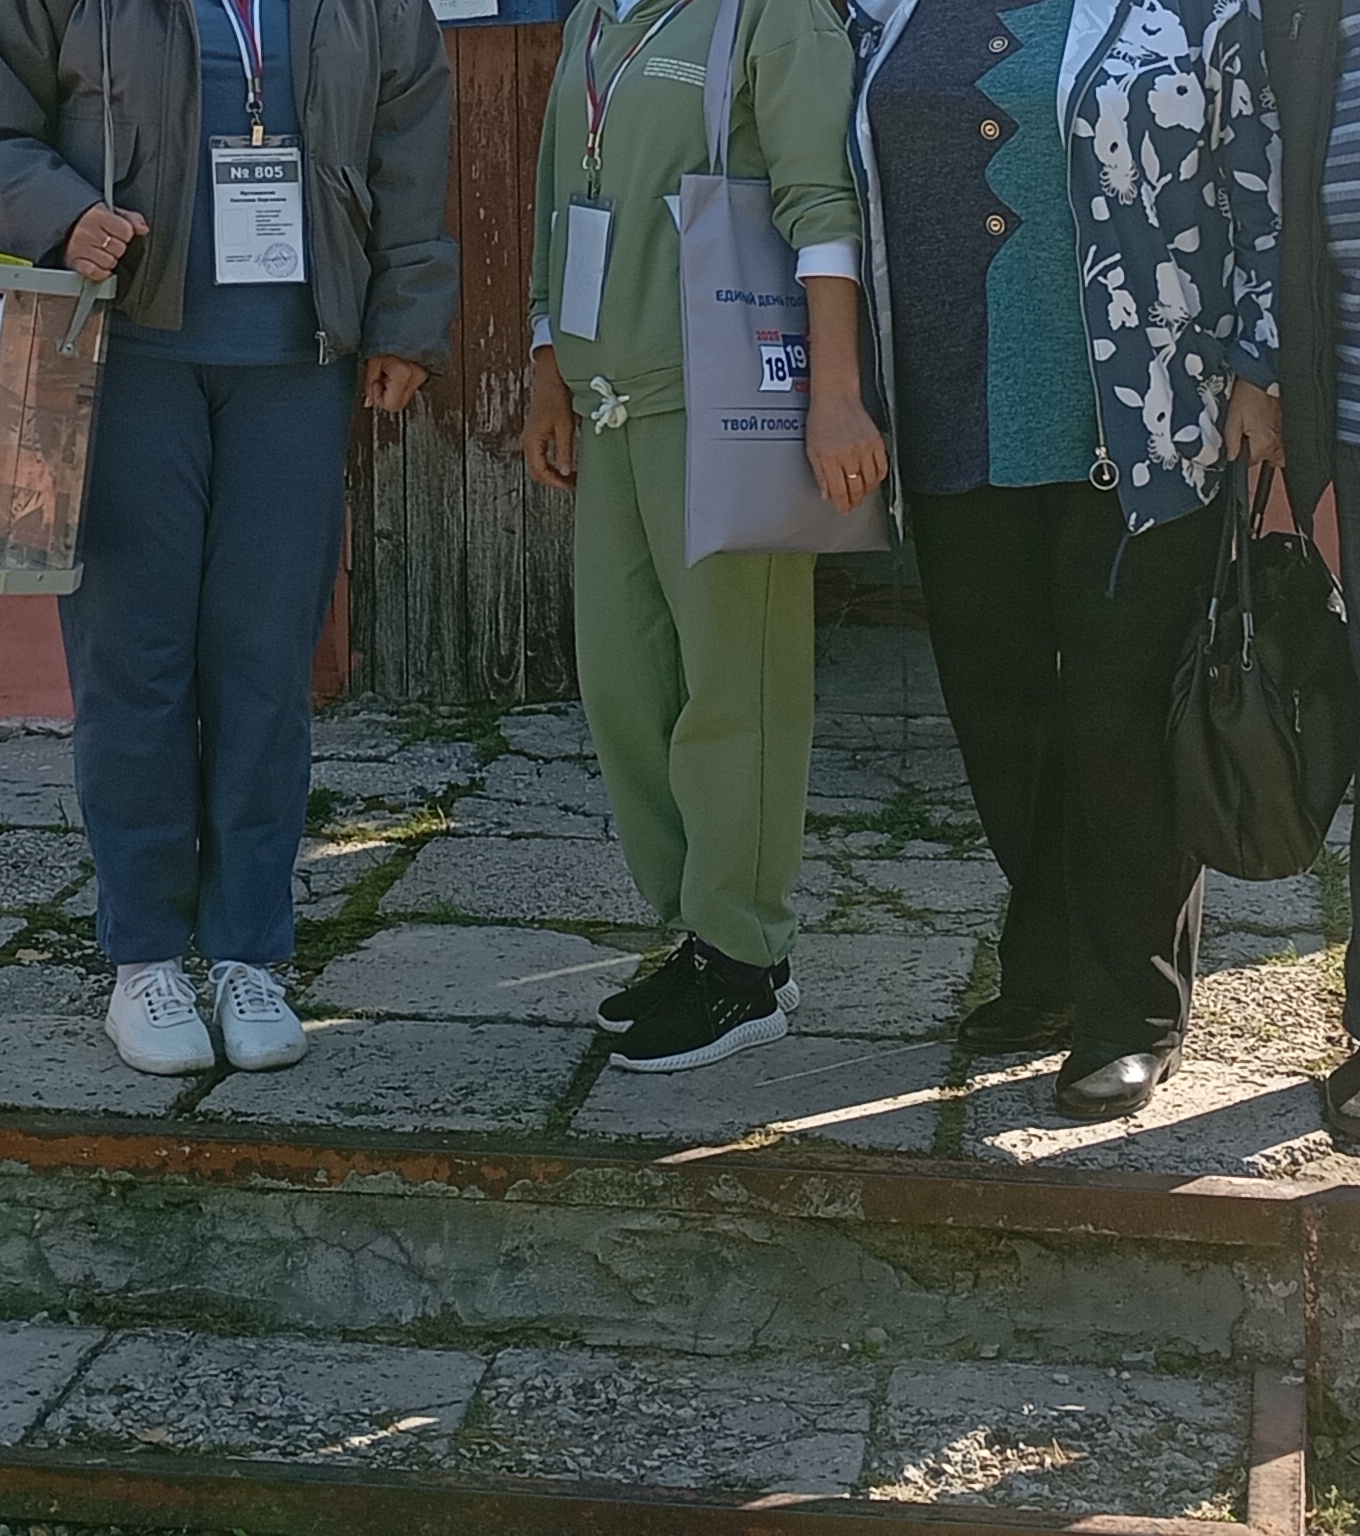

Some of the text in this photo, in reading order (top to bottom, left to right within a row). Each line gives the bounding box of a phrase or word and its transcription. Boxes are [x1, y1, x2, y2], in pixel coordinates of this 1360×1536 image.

[230, 166, 284, 180] № 805
[786, 344, 807, 369] 19
[765, 356, 787, 382] 18
[721, 416, 758, 431] ТВОЙ
[760, 418, 800, 431] ГОЛОС
